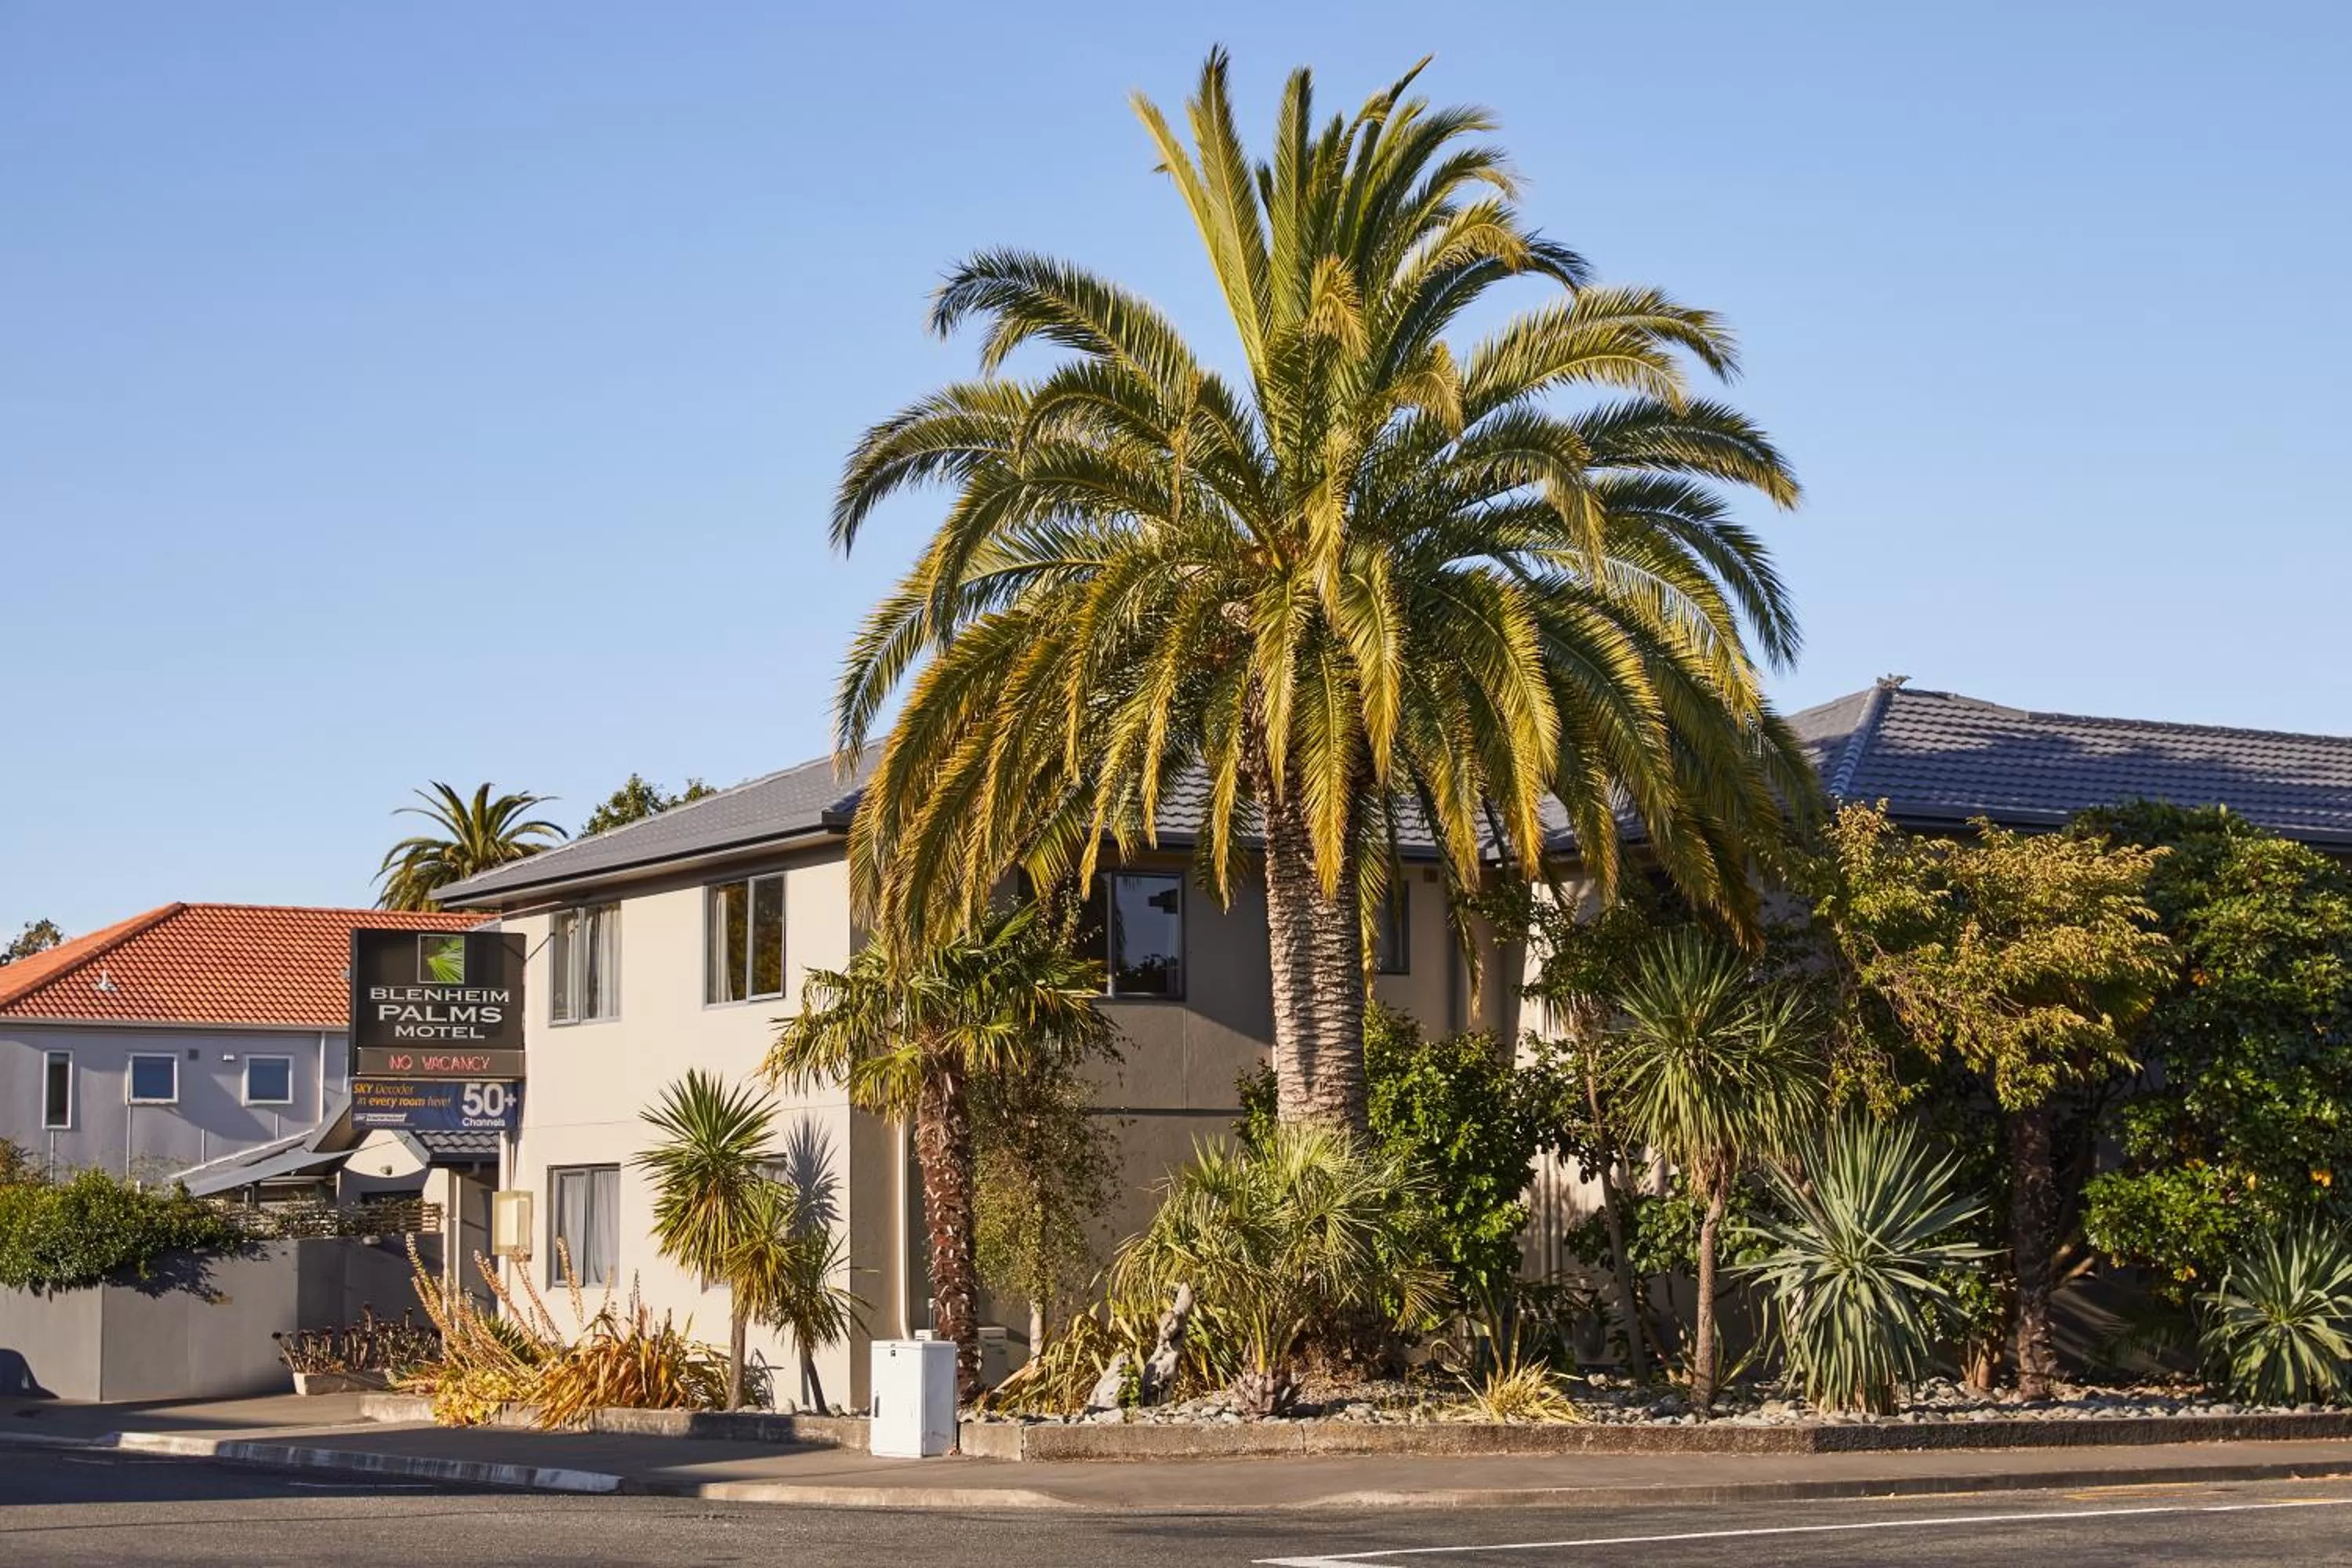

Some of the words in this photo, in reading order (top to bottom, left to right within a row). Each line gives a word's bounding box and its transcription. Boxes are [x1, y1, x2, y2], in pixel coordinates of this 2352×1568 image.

[370, 988, 510, 1003] BLENHEIM
[379, 1005, 503, 1023] PALMS
[394, 1025, 485, 1039] MOTEL
[389, 1054, 413, 1070] NO
[422, 1056, 490, 1071] VACANCY
[353, 1083, 373, 1093] SKY
[376, 1083, 414, 1094] Decoder
[357, 1096, 366, 1105] in
[369, 1097, 397, 1109] every
[399, 1098, 426, 1106] room
[462, 1083, 517, 1116] 50+
[462, 1117, 506, 1127] Channels
